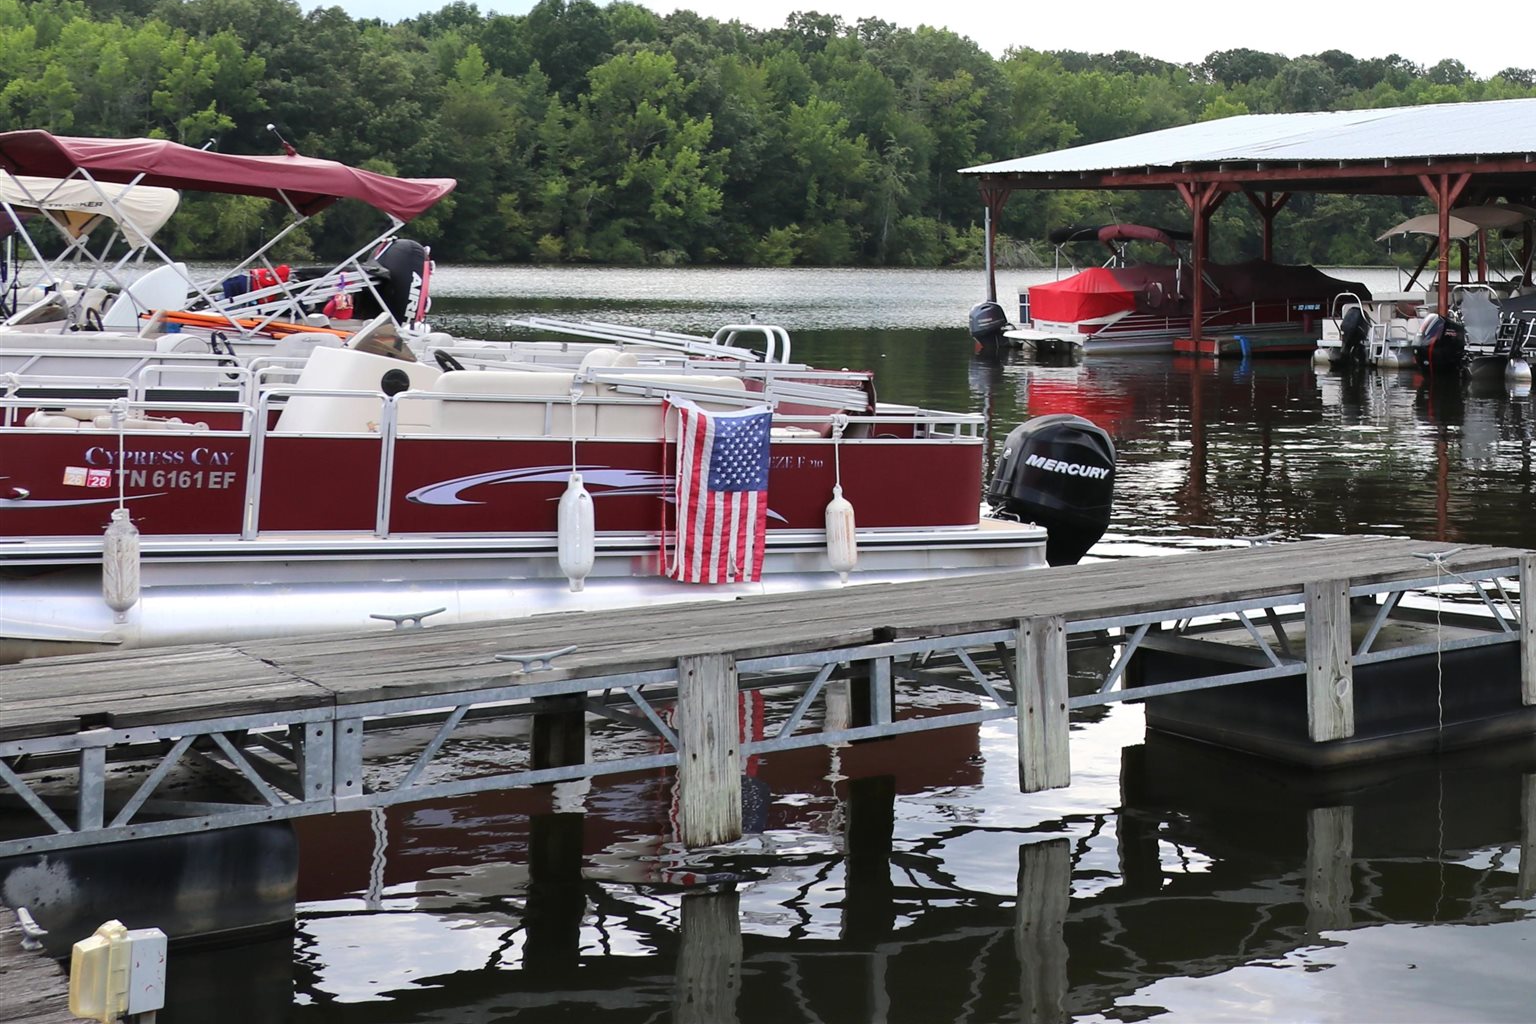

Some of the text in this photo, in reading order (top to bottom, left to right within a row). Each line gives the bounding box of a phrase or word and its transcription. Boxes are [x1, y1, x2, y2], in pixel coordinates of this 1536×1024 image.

[85, 447, 234, 465] CYPRESS CAY
[1025, 454, 1110, 480] MERCURY
[92, 476, 107, 487] 28
[115, 469, 236, 489] TN 6161 EF
